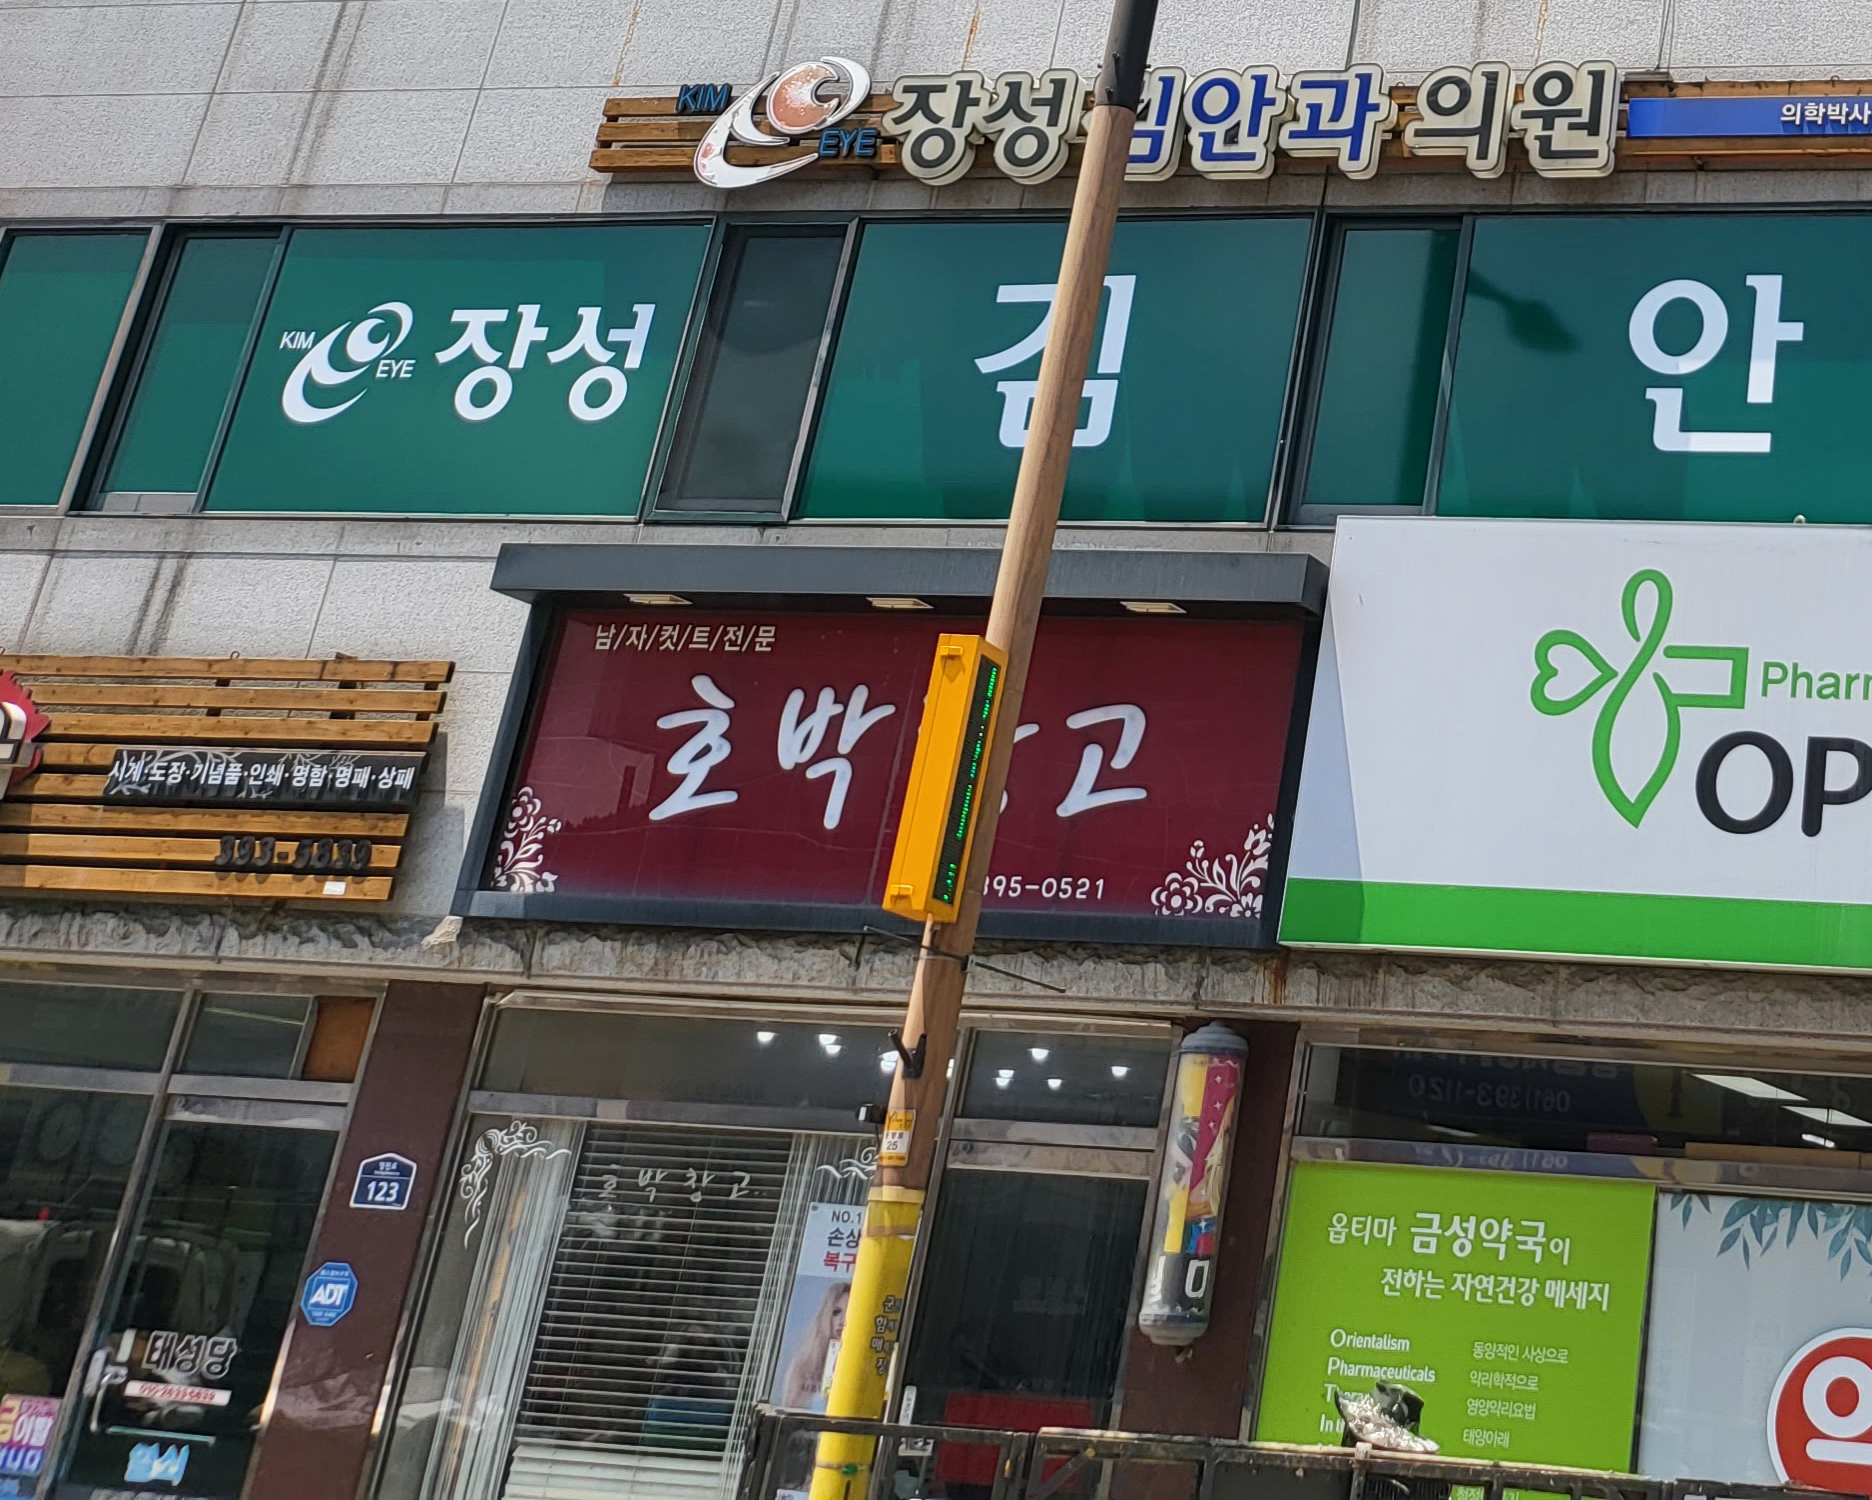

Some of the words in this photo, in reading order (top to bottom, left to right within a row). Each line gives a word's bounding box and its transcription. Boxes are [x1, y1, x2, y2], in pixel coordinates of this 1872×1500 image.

[676, 82, 733, 114] KIM
[819, 128, 877, 157] EYE
[897, 77, 1063, 169] 장성
[1413, 69, 1606, 160] 의원
[1780, 102, 1872, 125] 의학박사
[279, 330, 314, 350] KIM
[375, 359, 415, 379] EYE
[435, 304, 656, 422] 장성
[1629, 274, 1804, 453] 안
[648, 674, 1147, 830] 호박고
[367, 1180, 399, 1202] 123
[1327, 1213, 1397, 1247] 옵티마
[1410, 1212, 1571, 1266] 금성약국이
[309, 1283, 349, 1306] ADT
[1380, 1268, 1445, 1300] 전하는
[1450, 1273, 1540, 1307] 자연건강
[1545, 1279, 1610, 1312] 메세지
[1330, 1328, 1410, 1352] Orientalism
[1327, 1356, 1436, 1383] Pharmaceuticals
